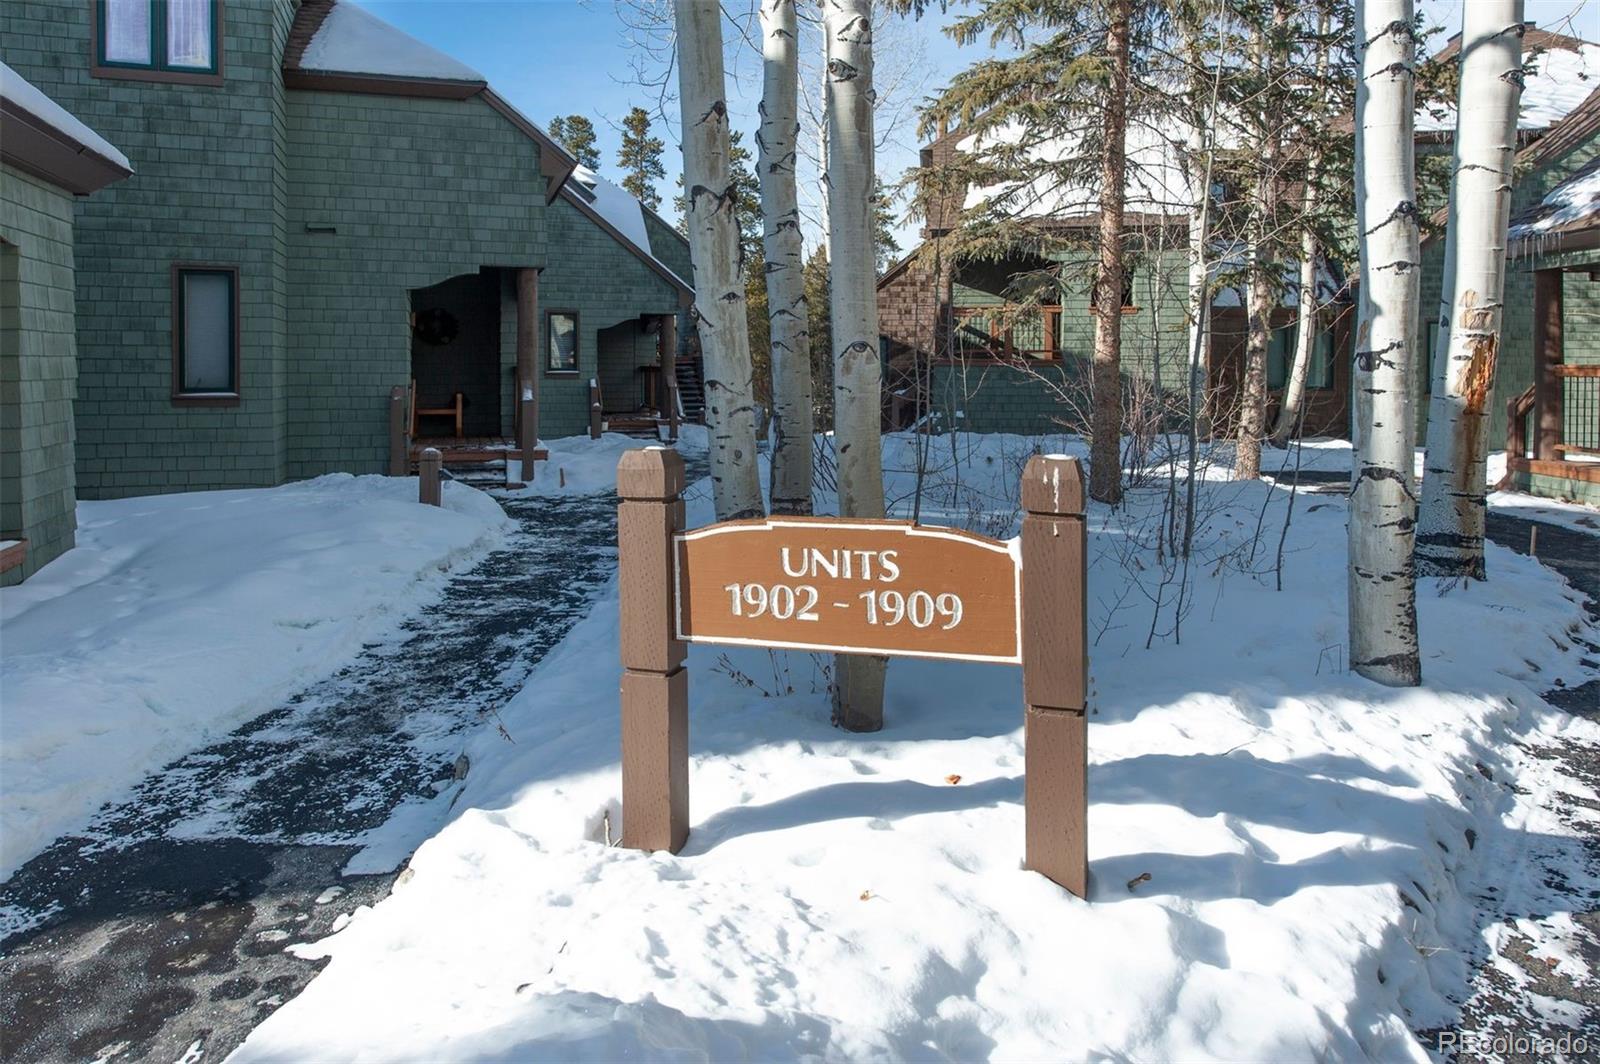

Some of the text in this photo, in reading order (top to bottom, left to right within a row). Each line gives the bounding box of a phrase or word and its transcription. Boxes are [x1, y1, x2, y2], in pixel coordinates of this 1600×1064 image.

[781, 547, 900, 582] UNITS
[724, 583, 819, 621] 1902
[859, 590, 963, 630] 1909
